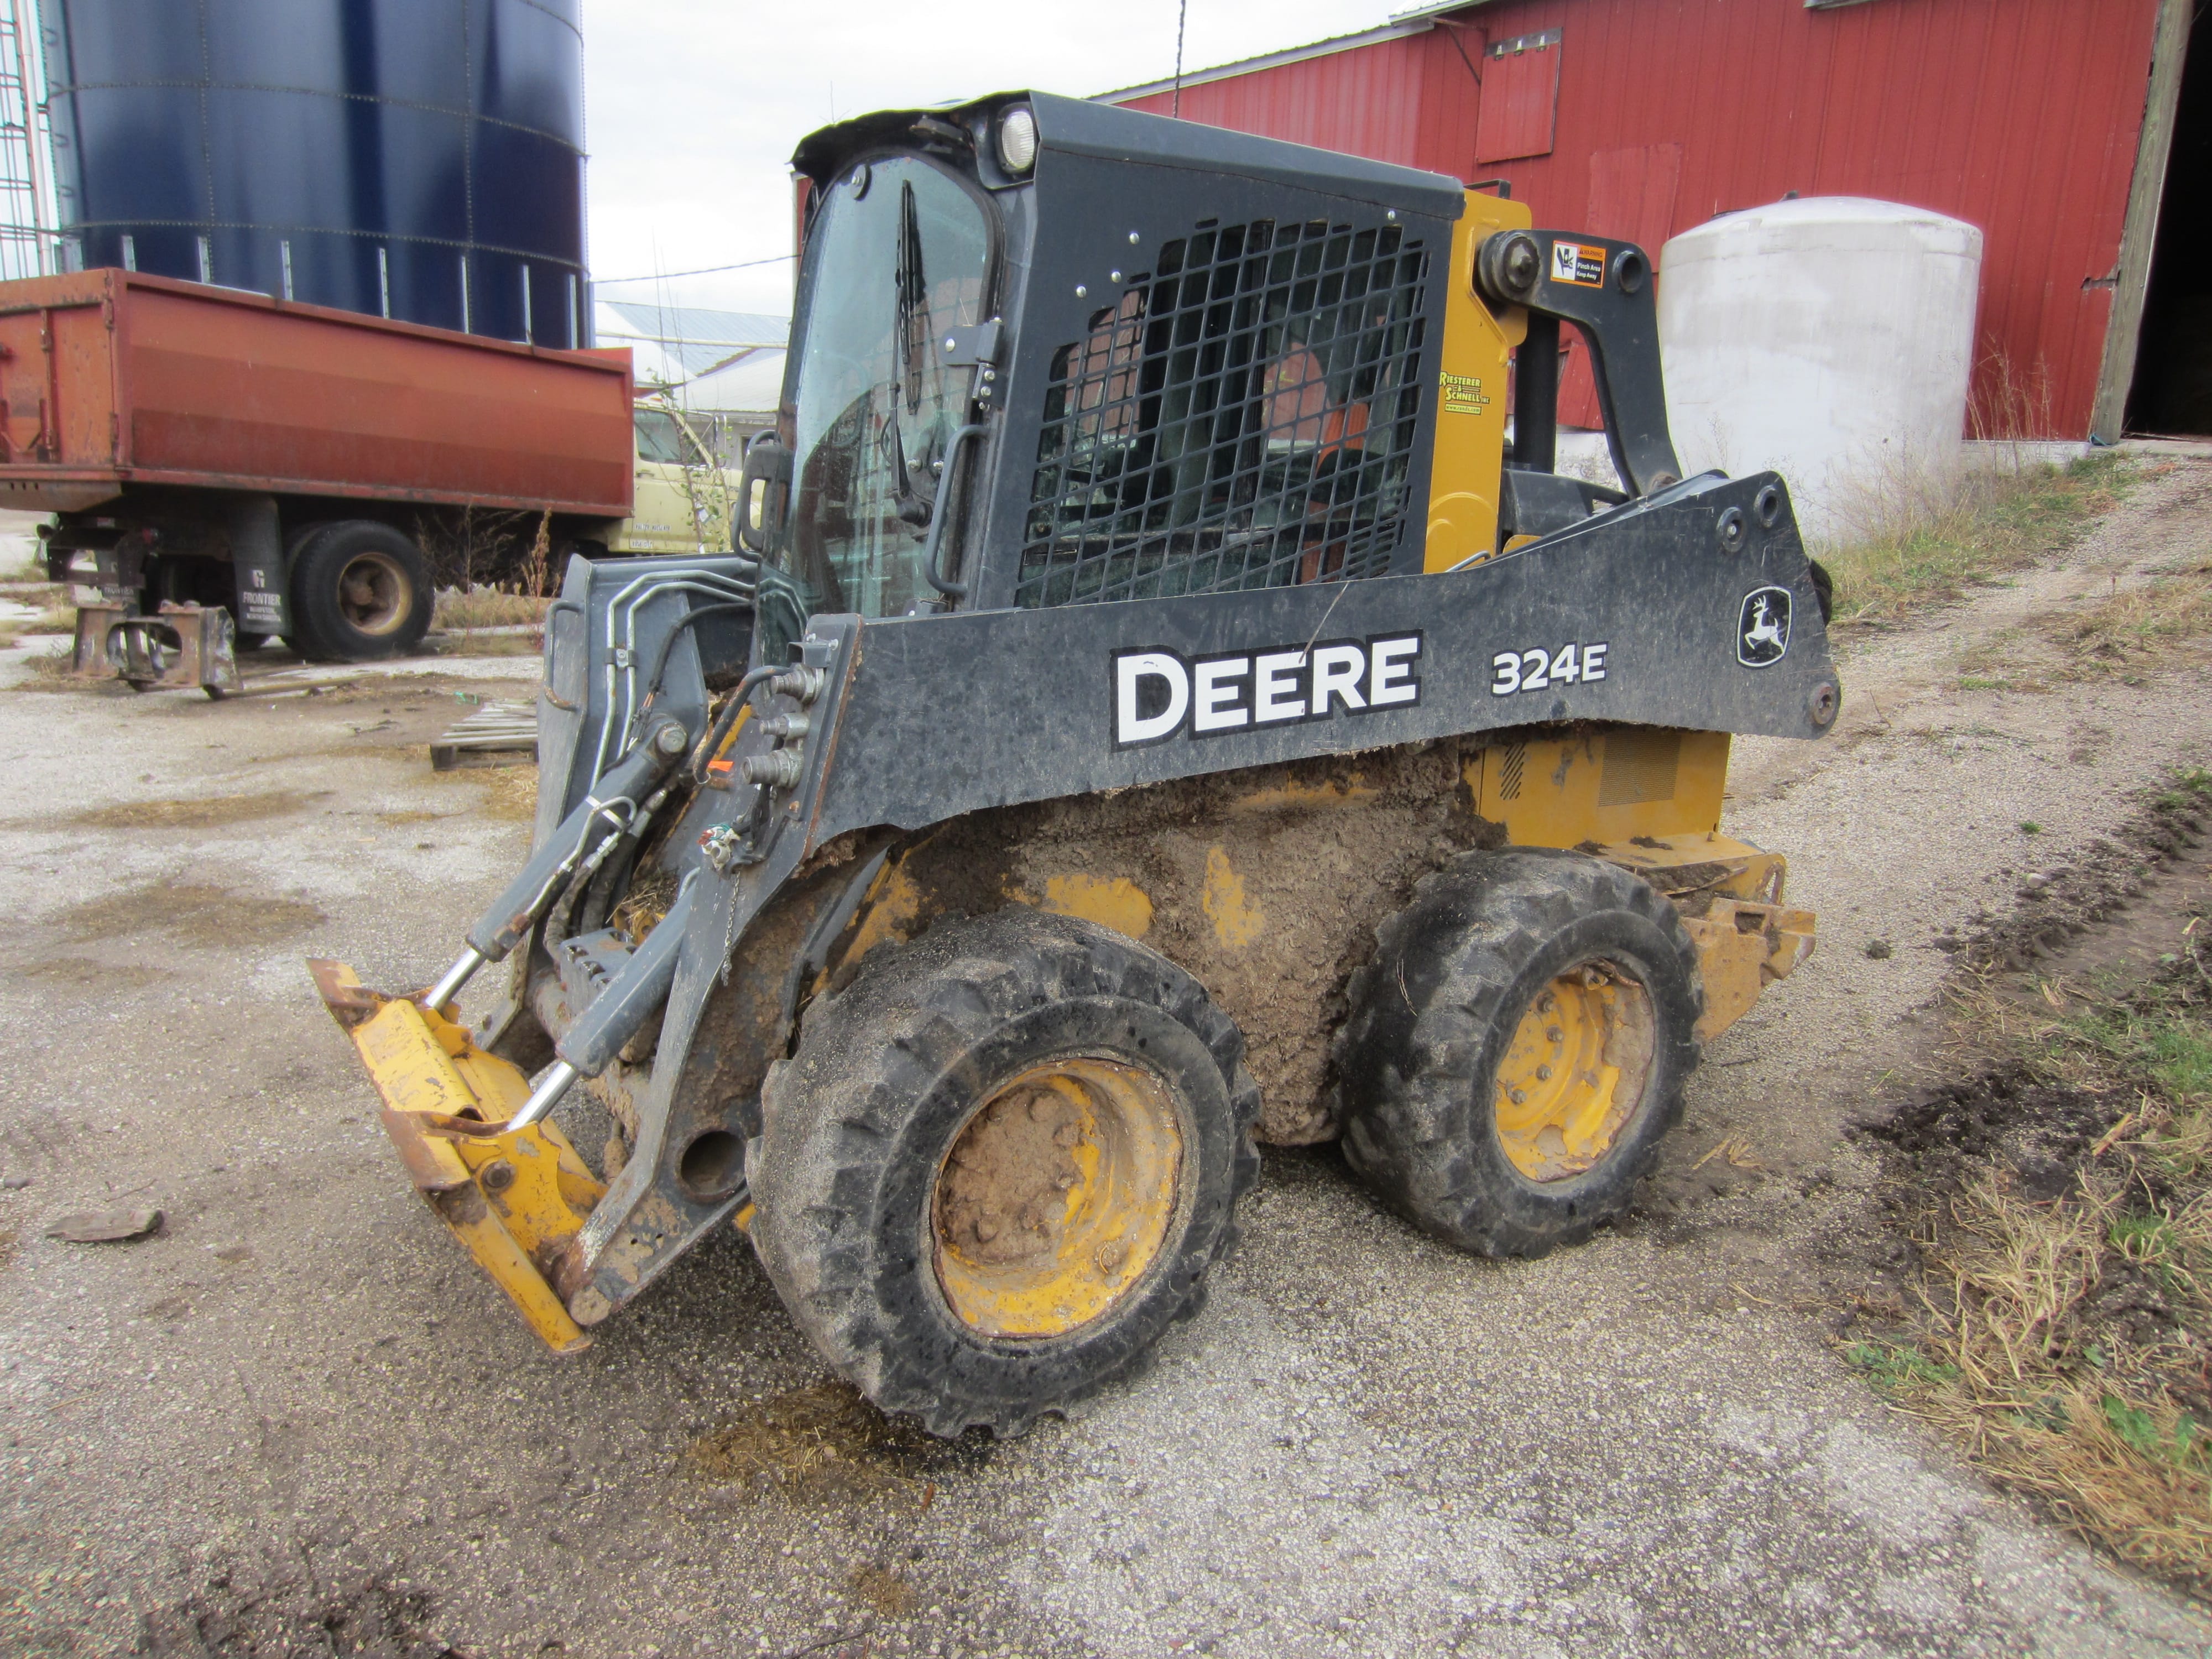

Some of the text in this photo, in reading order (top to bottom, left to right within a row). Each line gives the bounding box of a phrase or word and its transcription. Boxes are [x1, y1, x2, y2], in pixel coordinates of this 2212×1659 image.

[1583, 249, 1603, 258] WARNING
[1577, 262, 1590, 270] Pinch
[1439, 371, 1481, 388] RIESTERER
[1446, 387, 1480, 403] SCHNELL
[243, 591, 281, 606] FRONTIER
[1492, 643, 1607, 695] 324E
[1116, 636, 1419, 744] DEERE
